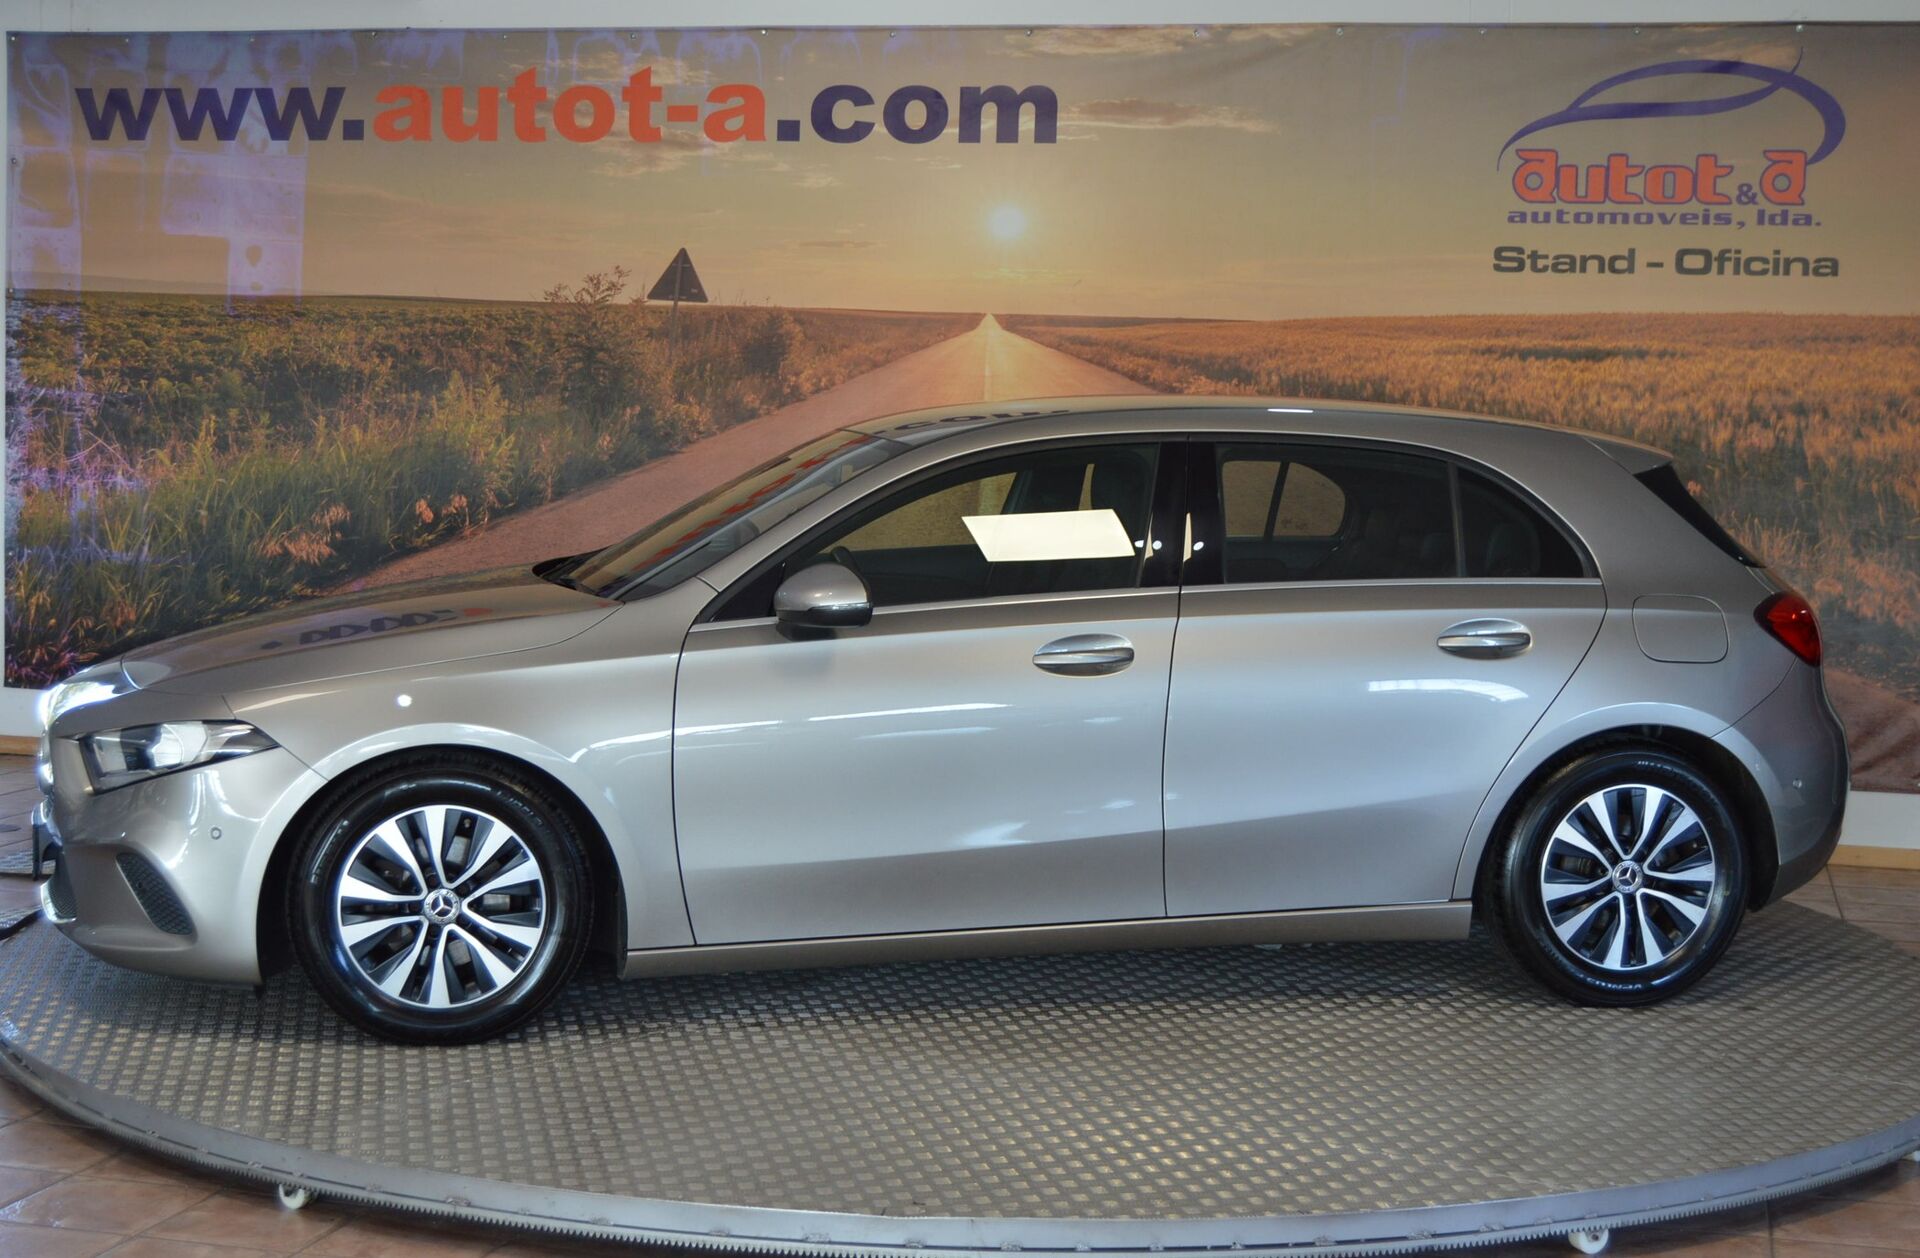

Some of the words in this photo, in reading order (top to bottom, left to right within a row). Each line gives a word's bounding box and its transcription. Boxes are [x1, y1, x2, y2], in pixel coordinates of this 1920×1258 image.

[76, 67, 1057, 142] www.autot-a.com
[1507, 208, 1746, 229] automoveis,
[1756, 209, 1823, 227] lda.
[1492, 246, 1636, 275] Stand
[1674, 247, 1840, 278] Oficina
